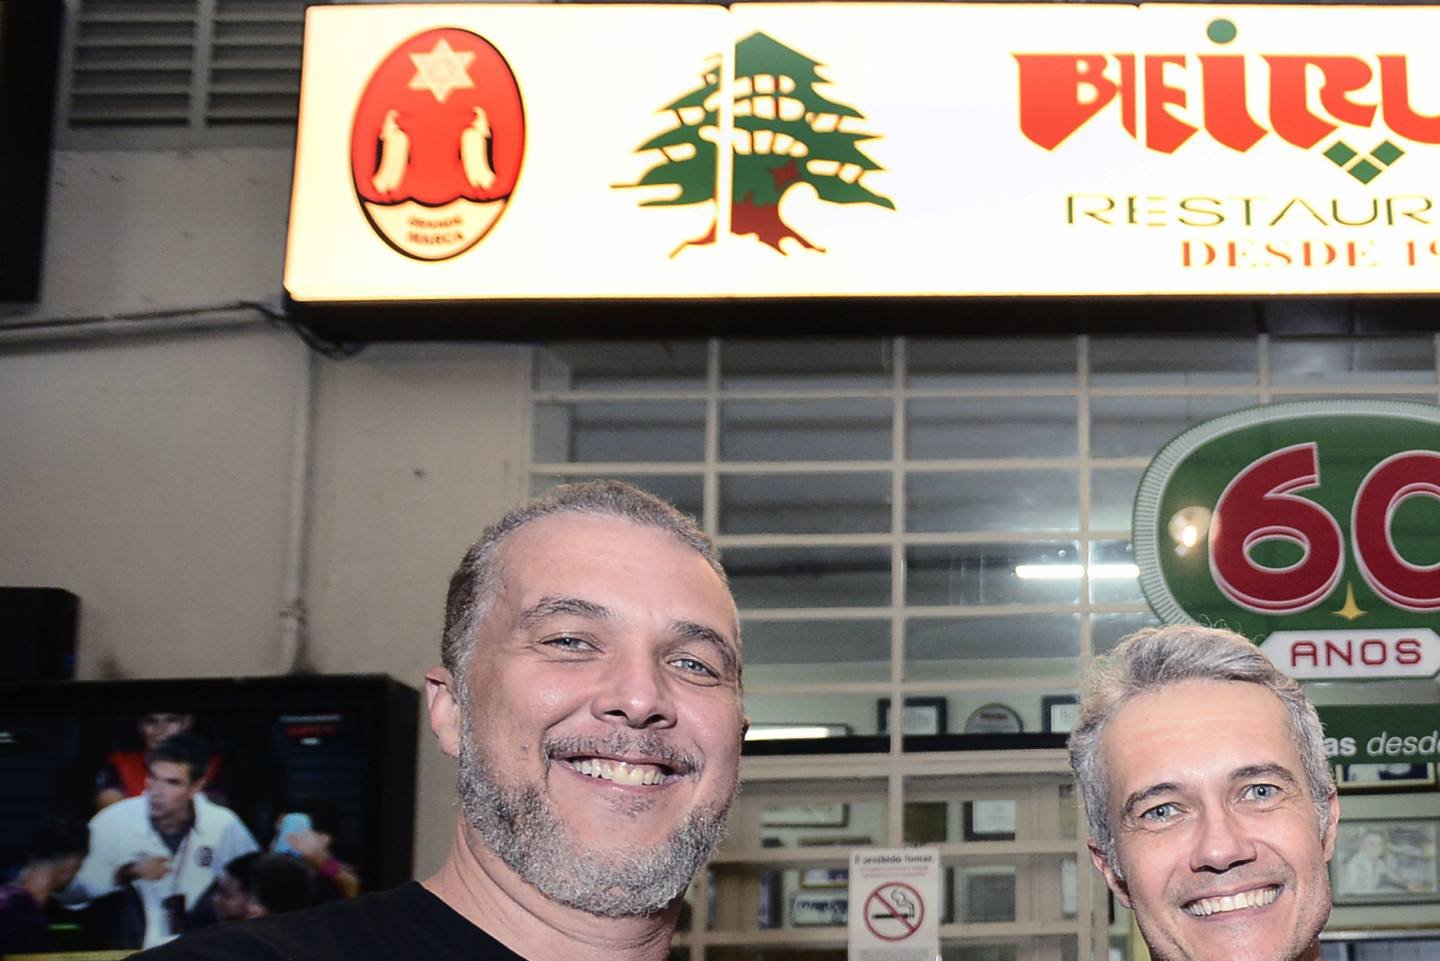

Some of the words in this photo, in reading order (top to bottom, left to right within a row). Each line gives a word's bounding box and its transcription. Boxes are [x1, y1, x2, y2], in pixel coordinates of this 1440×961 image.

[1181, 240, 1377, 268] DESDE
[1290, 638, 1423, 667] ANOS
[1322, 737, 1357, 757] as
